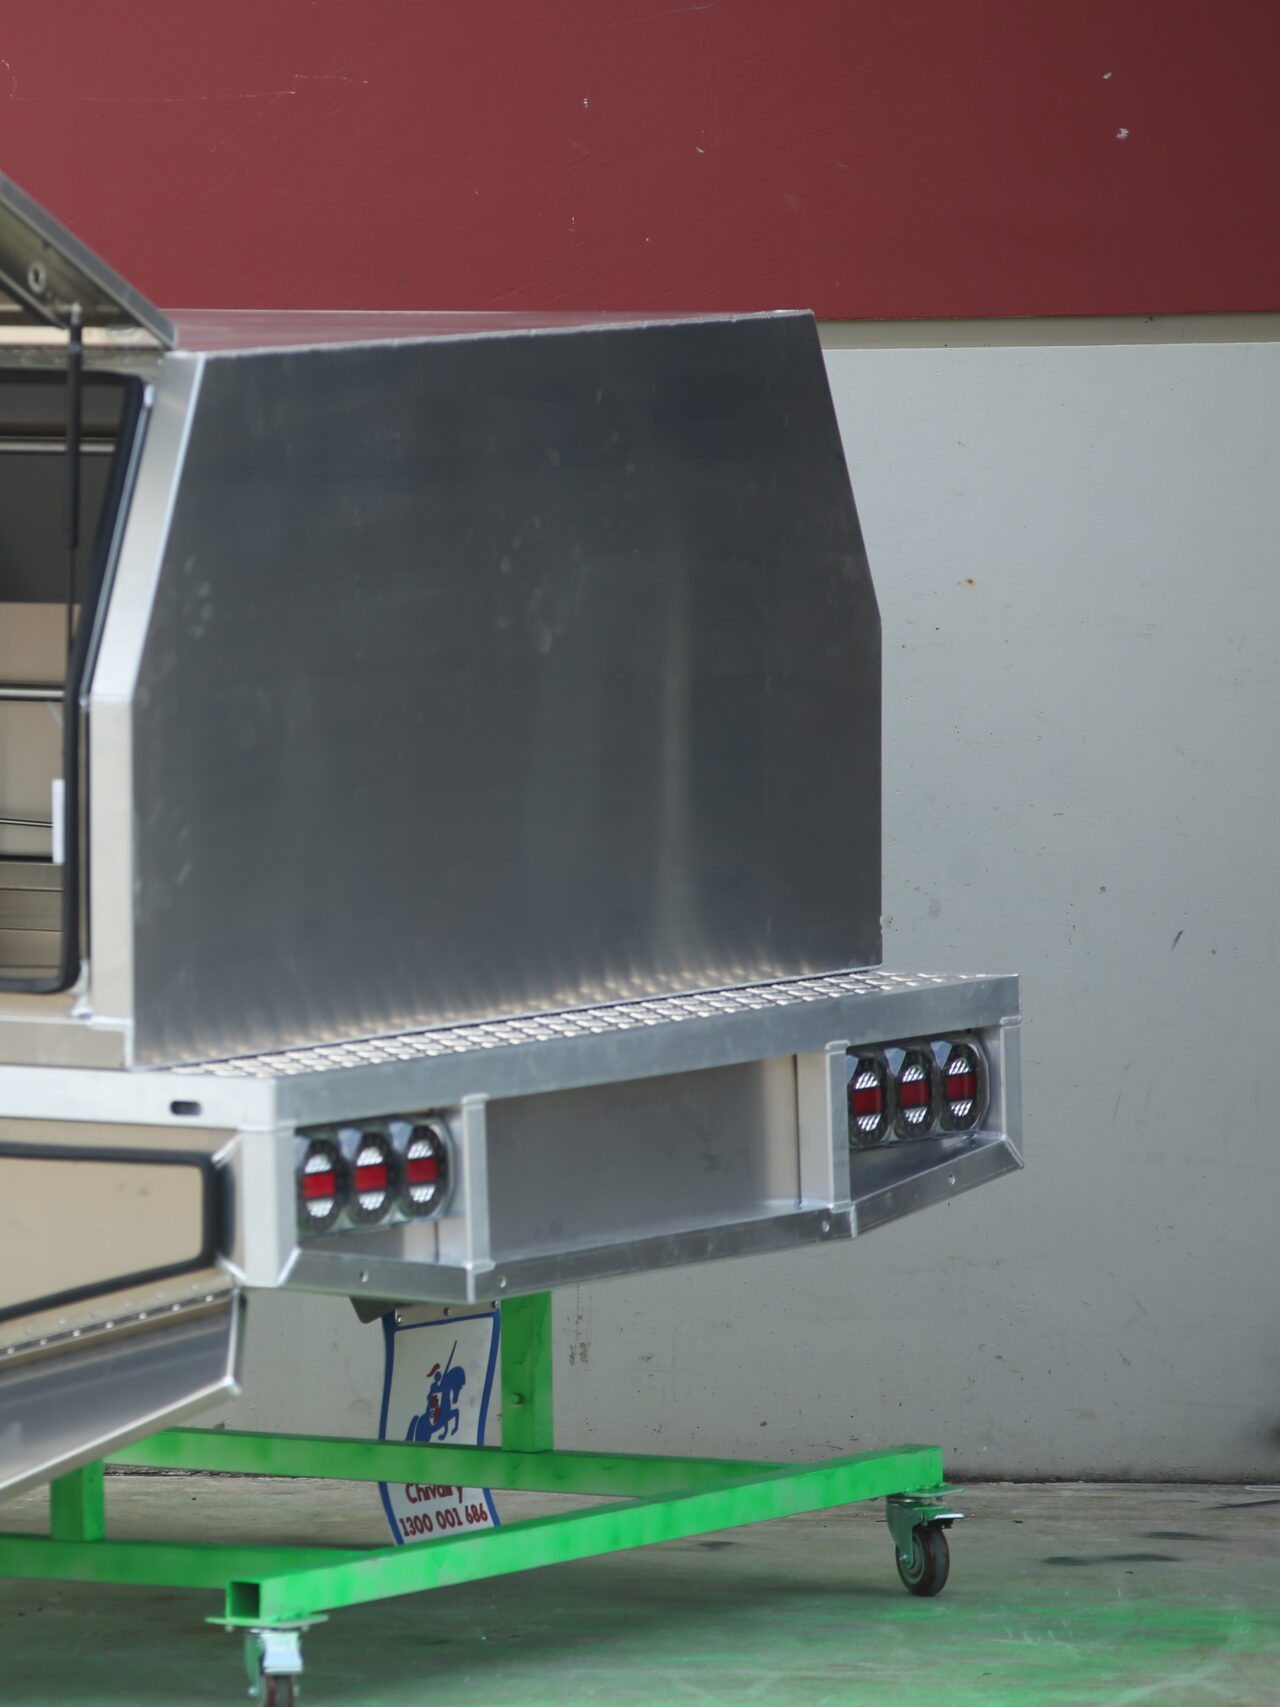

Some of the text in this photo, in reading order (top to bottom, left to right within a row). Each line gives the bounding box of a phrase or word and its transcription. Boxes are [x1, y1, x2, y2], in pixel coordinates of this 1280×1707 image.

[399, 1502, 488, 1537] 1300 001 686
